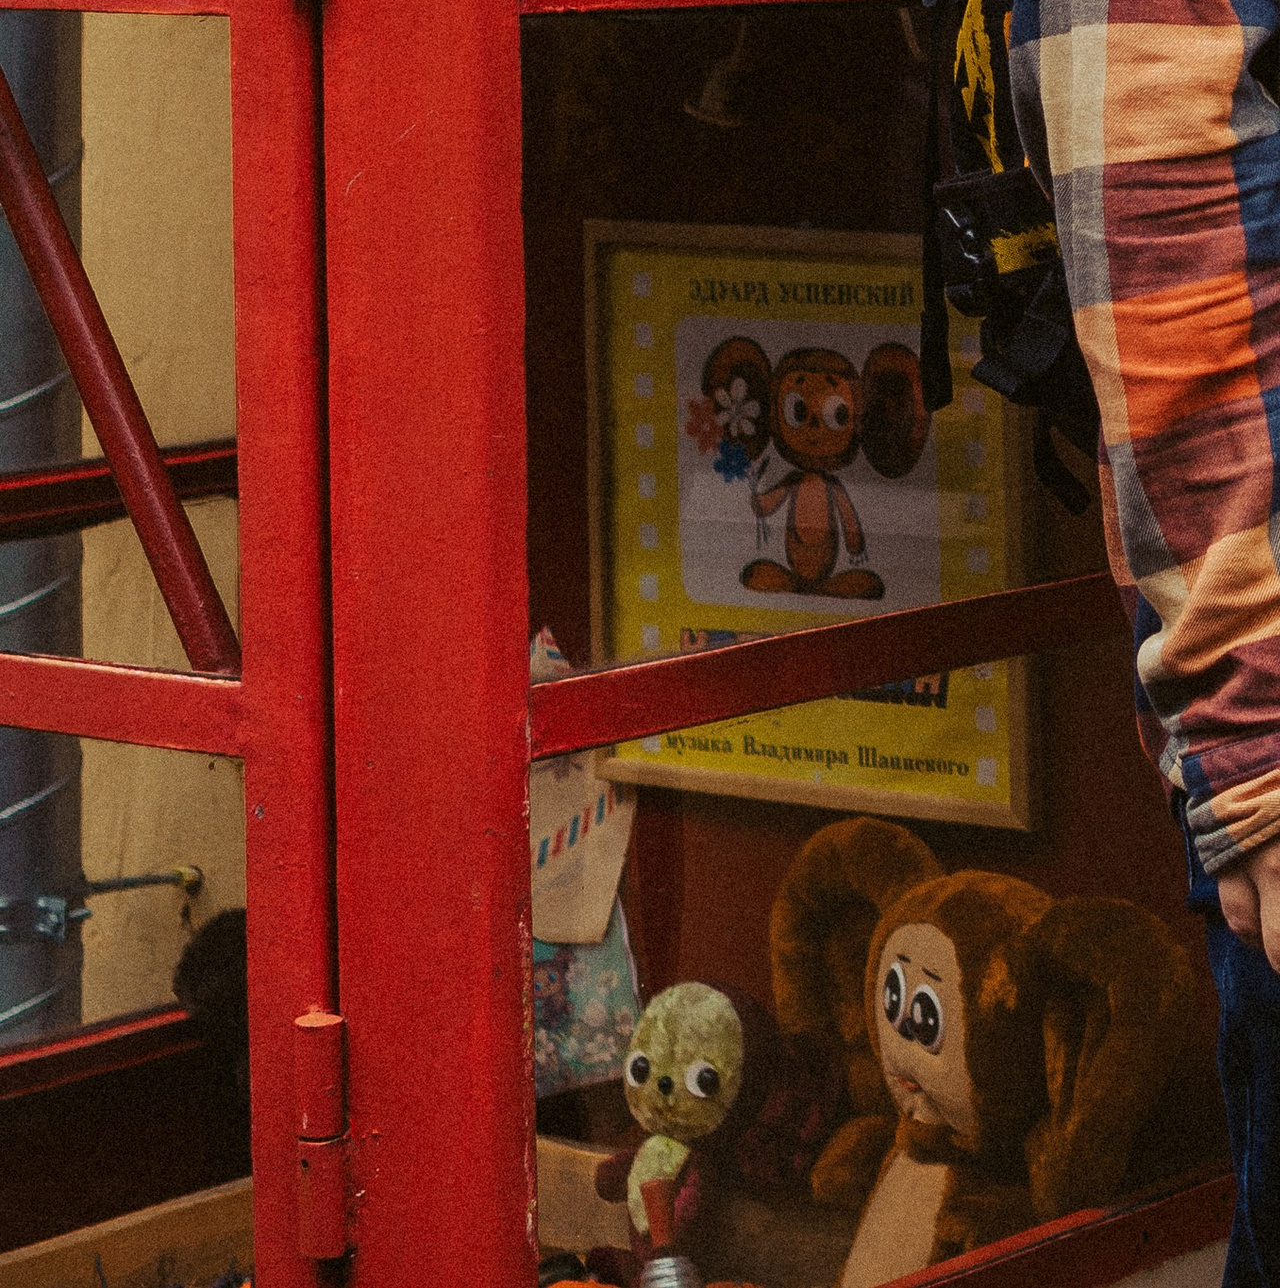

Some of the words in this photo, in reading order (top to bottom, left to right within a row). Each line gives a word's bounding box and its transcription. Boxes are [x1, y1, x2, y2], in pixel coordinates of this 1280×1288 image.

[688, 278, 770, 306] ЭДУАРД
[778, 280, 915, 308] УСПЕНСКИЙ
[665, 734, 733, 756] музыка
[743, 734, 850, 770] Владимира
[857, 744, 971, 777] Шаинского
